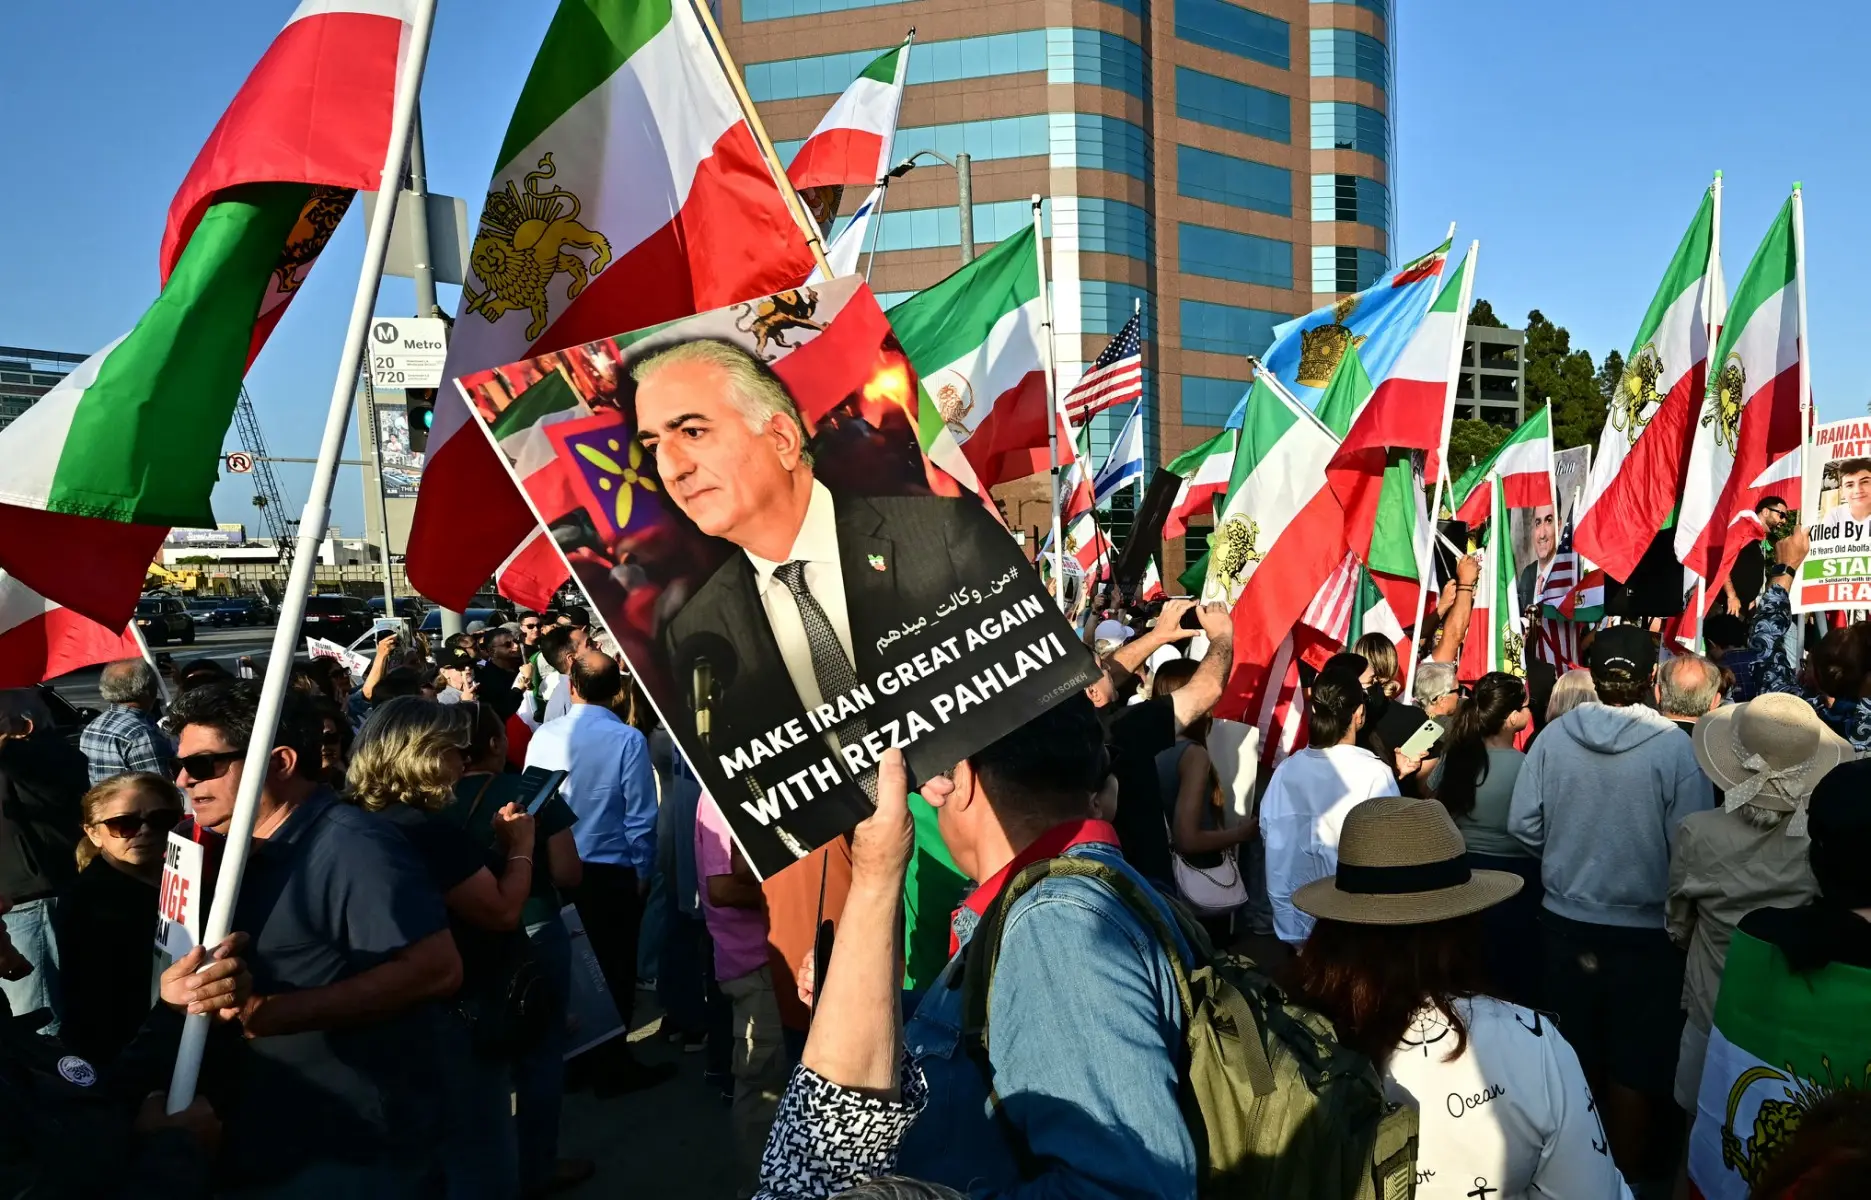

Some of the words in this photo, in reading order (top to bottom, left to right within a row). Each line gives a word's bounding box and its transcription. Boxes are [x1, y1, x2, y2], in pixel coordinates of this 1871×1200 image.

[404, 339, 442, 349] Metro
[375, 357, 395, 369] 20
[377, 371, 405, 383] 720
[1844, 520, 1863, 541] By
[1810, 547, 1816, 556] 16
[1818, 546, 1833, 555] Years
[1835, 544, 1845, 553] Old
[1848, 543, 1871, 552] Abolfa
[718, 718, 809, 780] MAKE
[806, 683, 876, 733] IRAN
[876, 636, 962, 695] GREAT
[965, 594, 1045, 652] AGAIN
[739, 757, 842, 826] WITH
[840, 710, 936, 775] REZA
[930, 632, 1067, 724] PAHLAVI
[1446, 1083, 1506, 1118] Ocean
